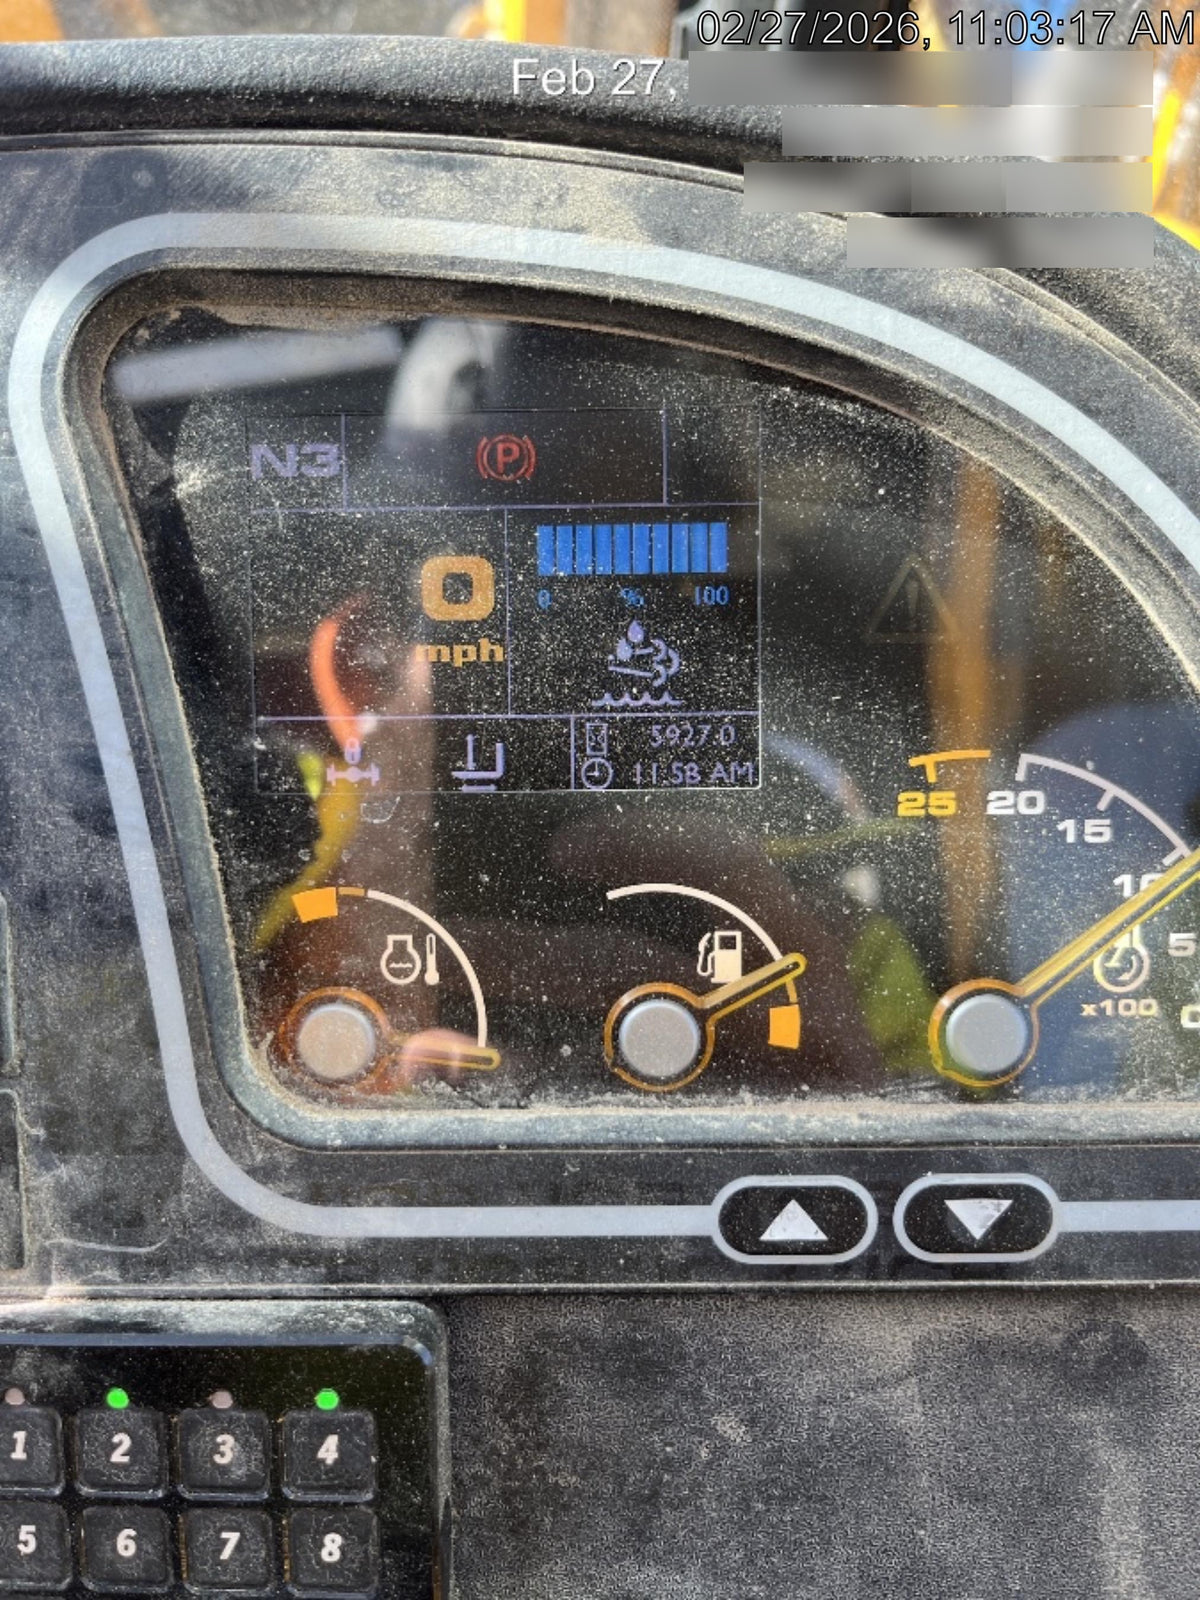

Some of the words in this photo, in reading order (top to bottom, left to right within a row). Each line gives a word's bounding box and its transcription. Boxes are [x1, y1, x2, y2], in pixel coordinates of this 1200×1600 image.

[250, 443, 342, 479] N3
[537, 588, 551, 609] 0
[694, 585, 729, 606] 100
[414, 638, 505, 667] mph
[709, 760, 756, 786] AM
[897, 790, 957, 816] 25
[986, 790, 1046, 816] 20
[1056, 819, 1113, 844] 15
[1168, 932, 1197, 957] 5
[1081, 998, 1159, 1018] x100
[10, 1430, 28, 1460] 1
[109, 1433, 131, 1464] 2
[212, 1434, 236, 1465] 3
[316, 1434, 340, 1465] 4
[17, 1525, 37, 1555] 5
[116, 1528, 137, 1558] 6
[219, 1532, 241, 1561] 7
[320, 1532, 342, 1563] 8
